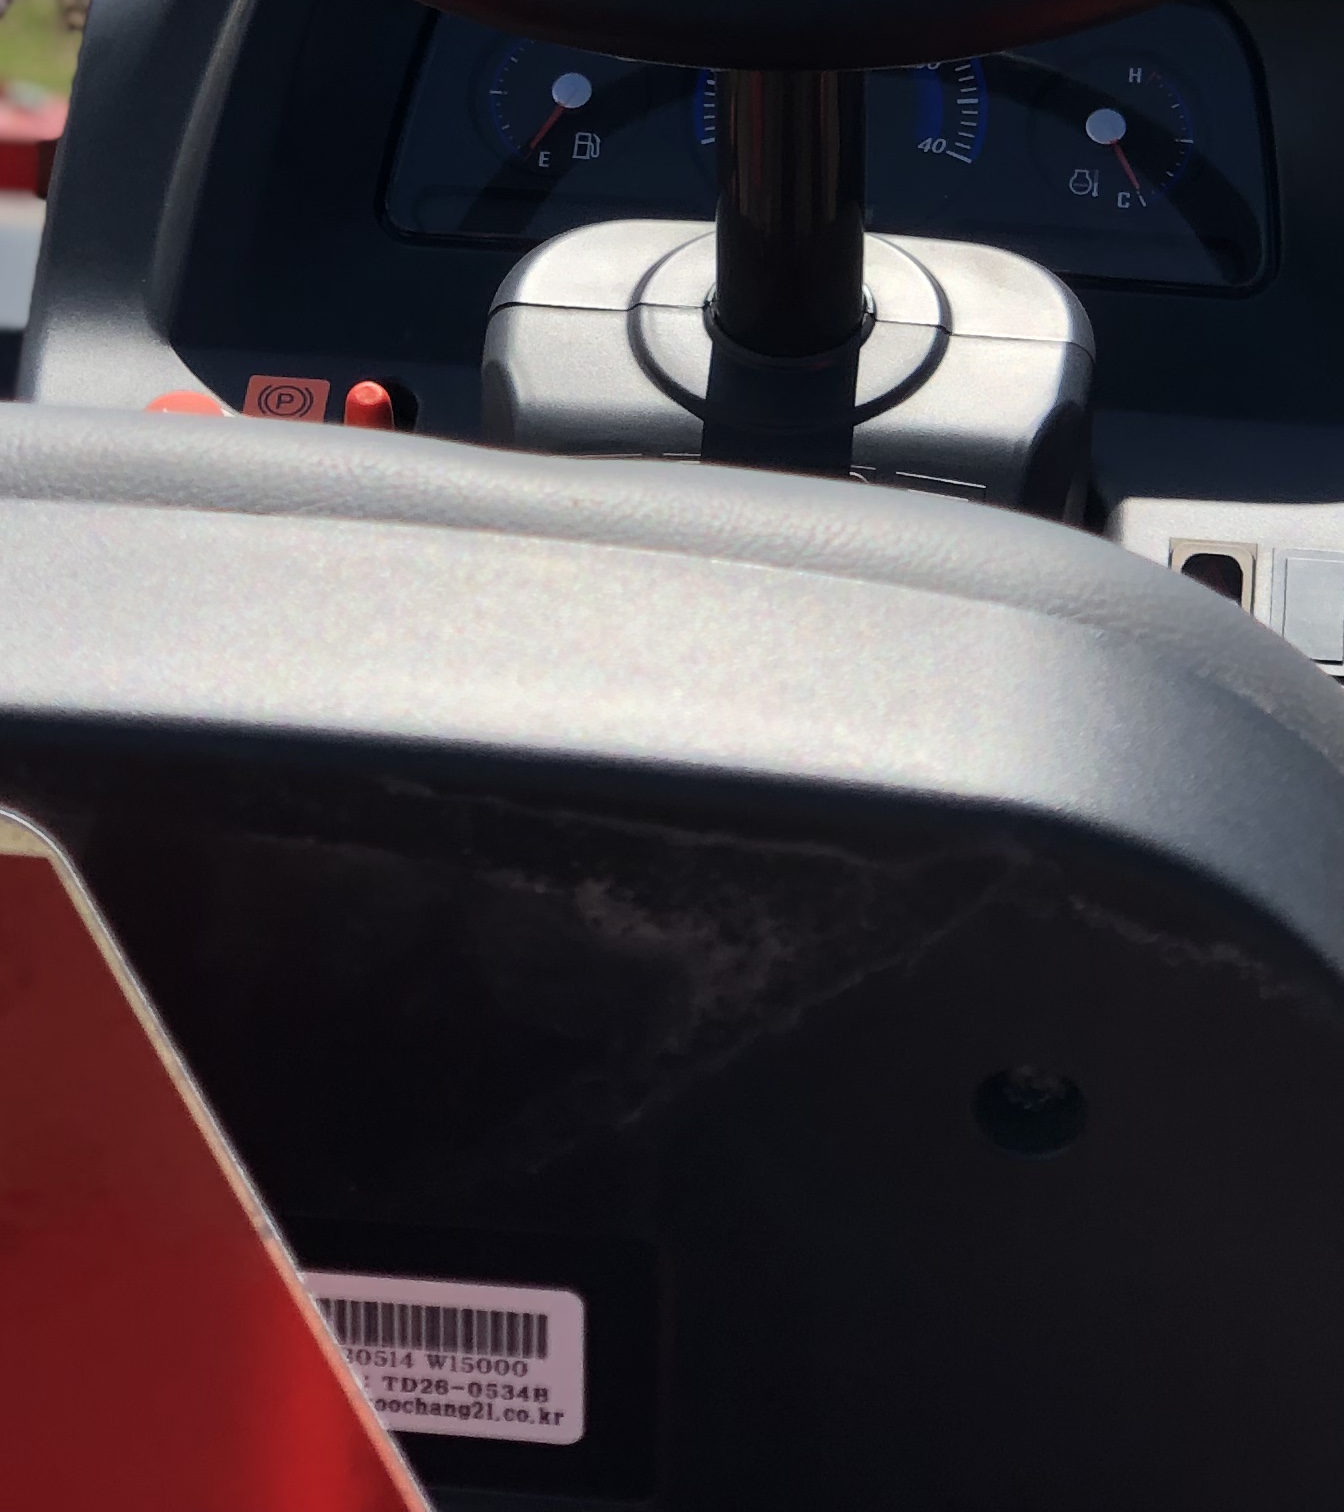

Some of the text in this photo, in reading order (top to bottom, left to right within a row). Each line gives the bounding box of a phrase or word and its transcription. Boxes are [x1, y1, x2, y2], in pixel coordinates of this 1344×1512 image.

[1128, 68, 1142, 83] H
[917, 138, 947, 154] 40
[539, 151, 551, 167] E
[1117, 192, 1130, 208] C
[426, 1353, 529, 1378] W15000
[373, 1398, 564, 1426] oochang21.co.kr
